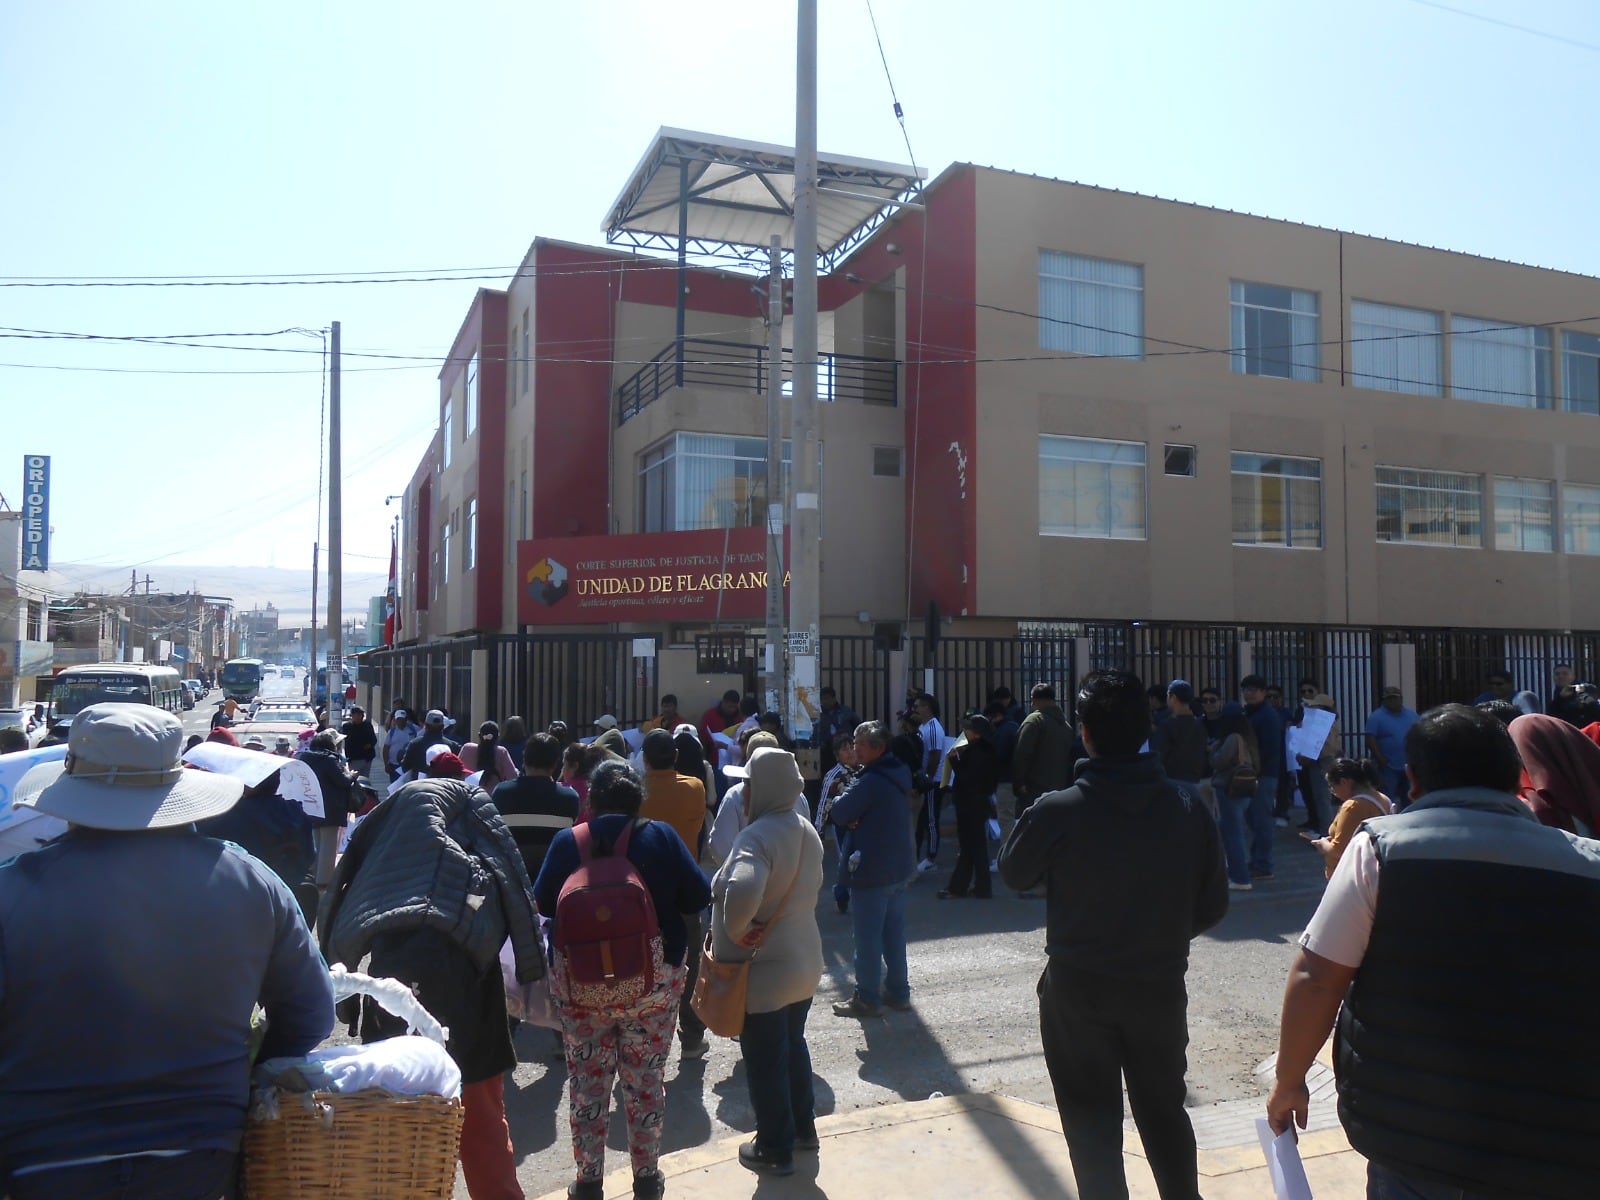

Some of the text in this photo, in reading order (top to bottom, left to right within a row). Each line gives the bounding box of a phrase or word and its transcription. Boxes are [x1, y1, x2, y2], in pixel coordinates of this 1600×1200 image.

[26, 456, 45, 568] ORTOPEDIA
[576, 560, 606, 571] CORTE
[609, 557, 656, 569] SUPERIOR
[660, 556, 673, 566] DE
[674, 554, 720, 567] JUSTICIA
[738, 551, 767, 563] TACN
[576, 577, 645, 595] UNIDAD
[648, 575, 673, 593] DE
